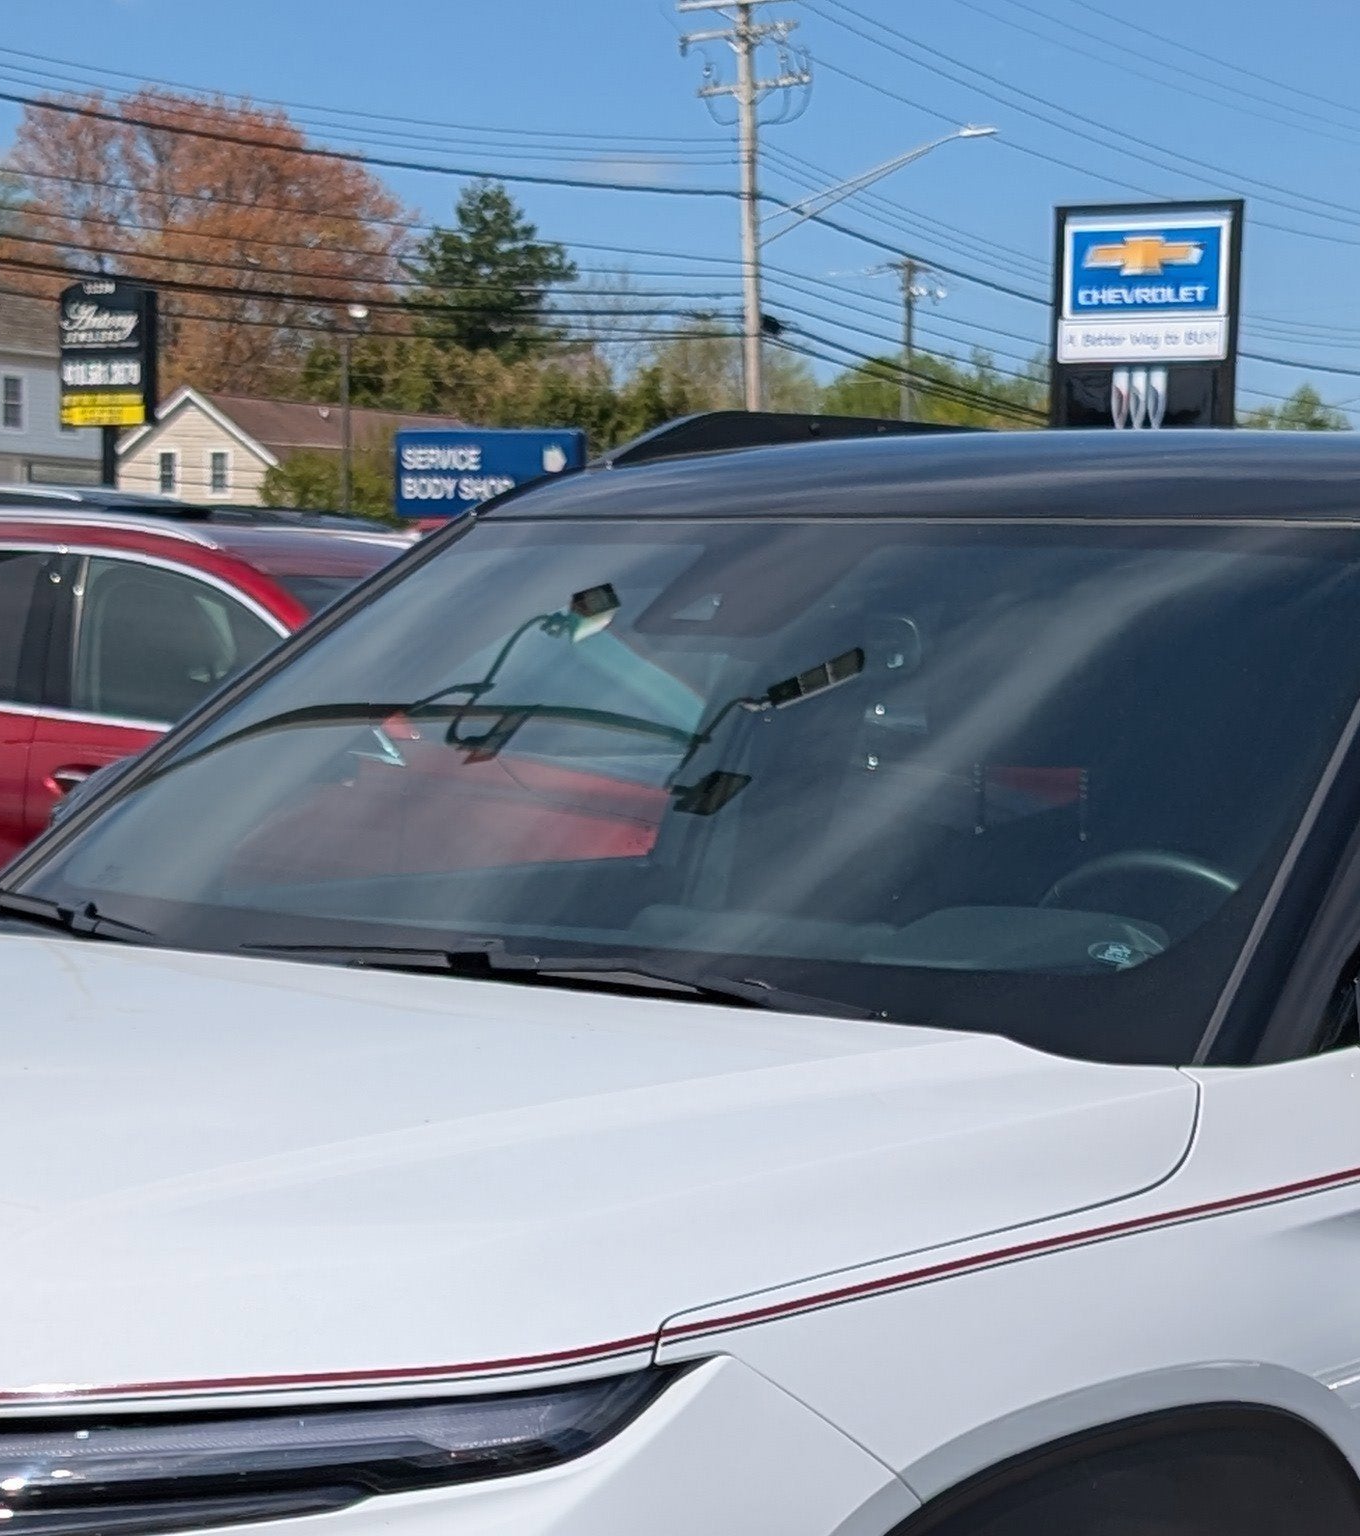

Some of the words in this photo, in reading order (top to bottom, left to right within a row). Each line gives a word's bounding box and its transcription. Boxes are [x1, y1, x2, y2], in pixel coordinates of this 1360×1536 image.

[1078, 285, 1209, 305] CHEVROLET
[61, 302, 139, 339] Antony
[401, 446, 482, 471] SERVICE
[401, 477, 458, 500] BODY
